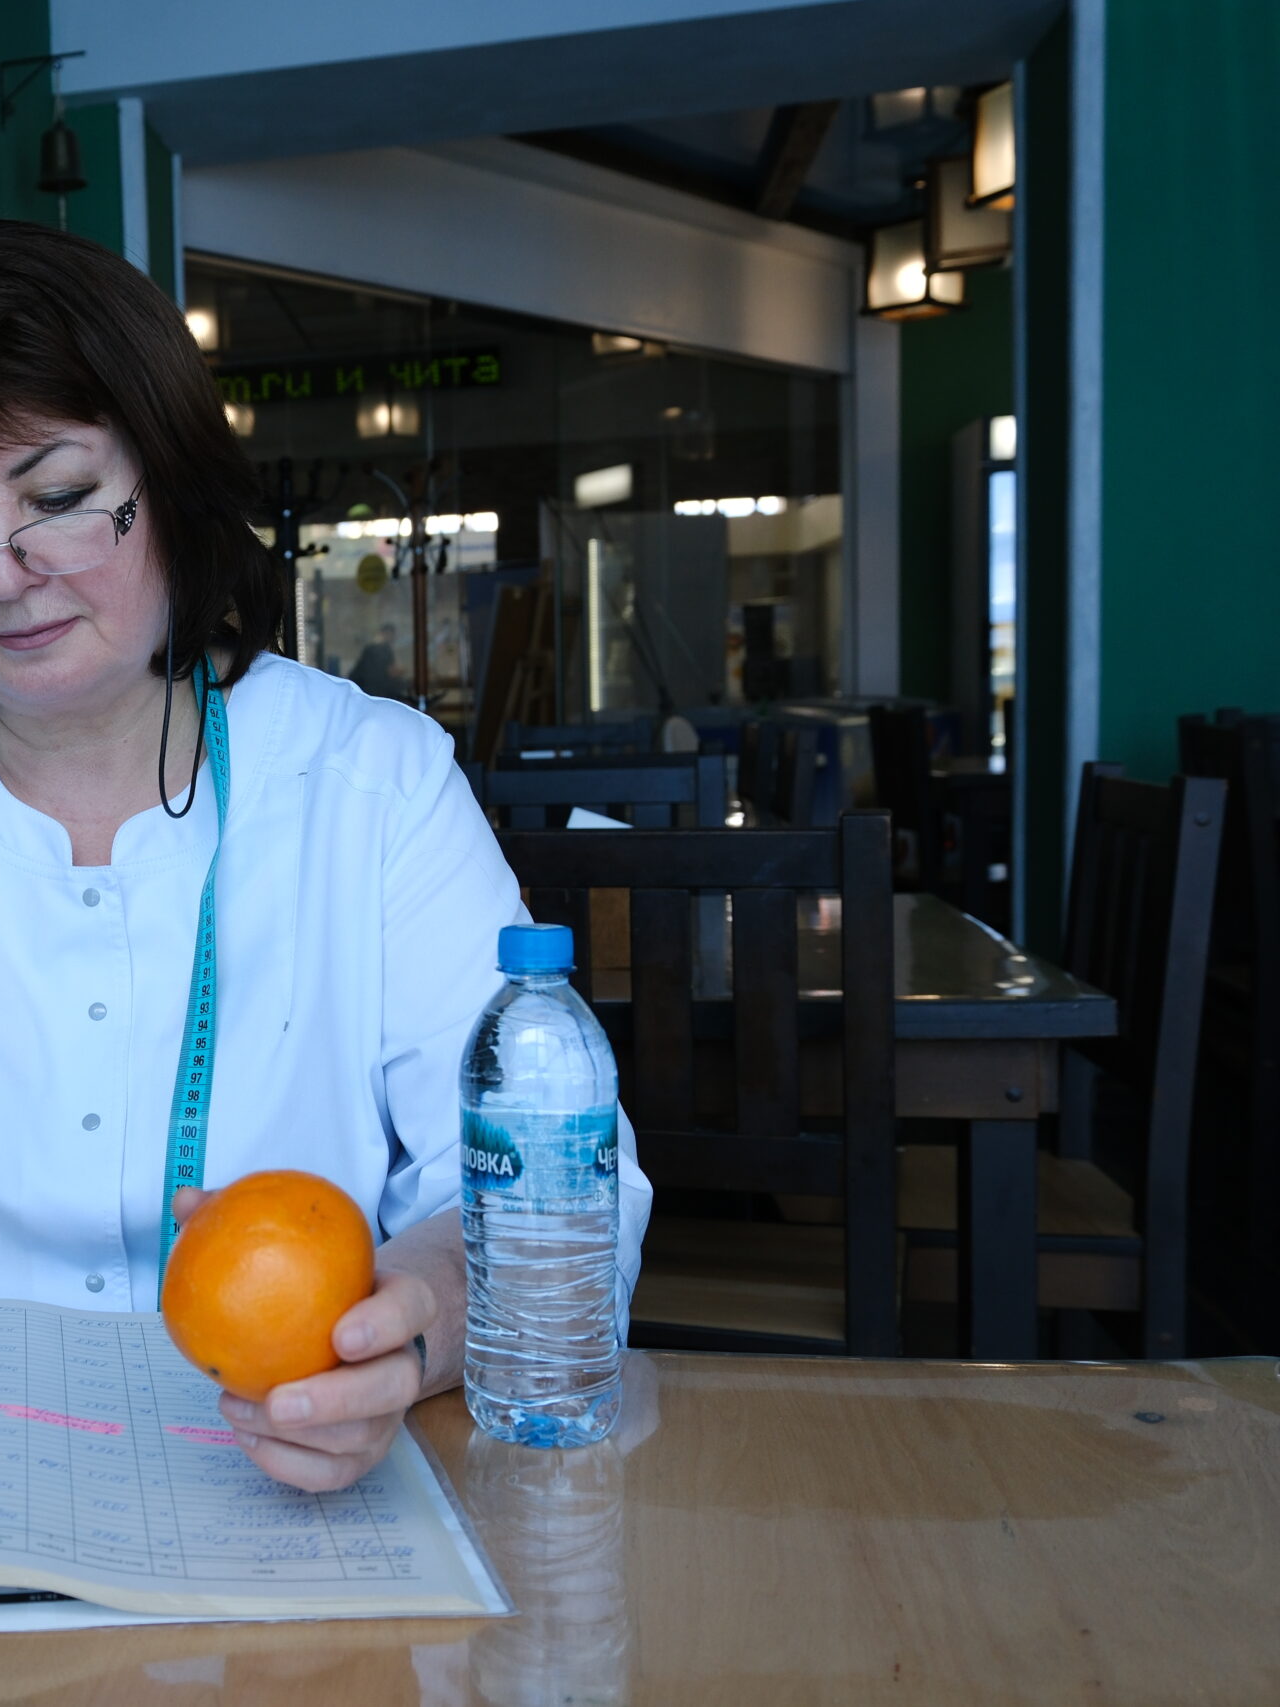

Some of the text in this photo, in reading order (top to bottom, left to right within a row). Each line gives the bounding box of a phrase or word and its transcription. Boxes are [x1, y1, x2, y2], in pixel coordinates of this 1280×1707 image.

[335, 365, 365, 395] и
[389, 354, 500, 388] чита
[210, 708, 220, 719] 76
[213, 722, 222, 733] 75
[215, 736, 224, 747] 74
[203, 967, 211, 979] 91
[201, 984, 211, 997] 92
[199, 1002, 210, 1014] 93
[198, 1020, 208, 1032] 94
[195, 1037, 207, 1049] 95
[193, 1055, 205, 1067] 96
[190, 1072, 203, 1084] 97
[187, 1090, 200, 1102] 98
[184, 1106, 197, 1119] 99
[180, 1125, 197, 1139] 100
[178, 1144, 194, 1158] 101
[177, 1164, 194, 1178] 102
